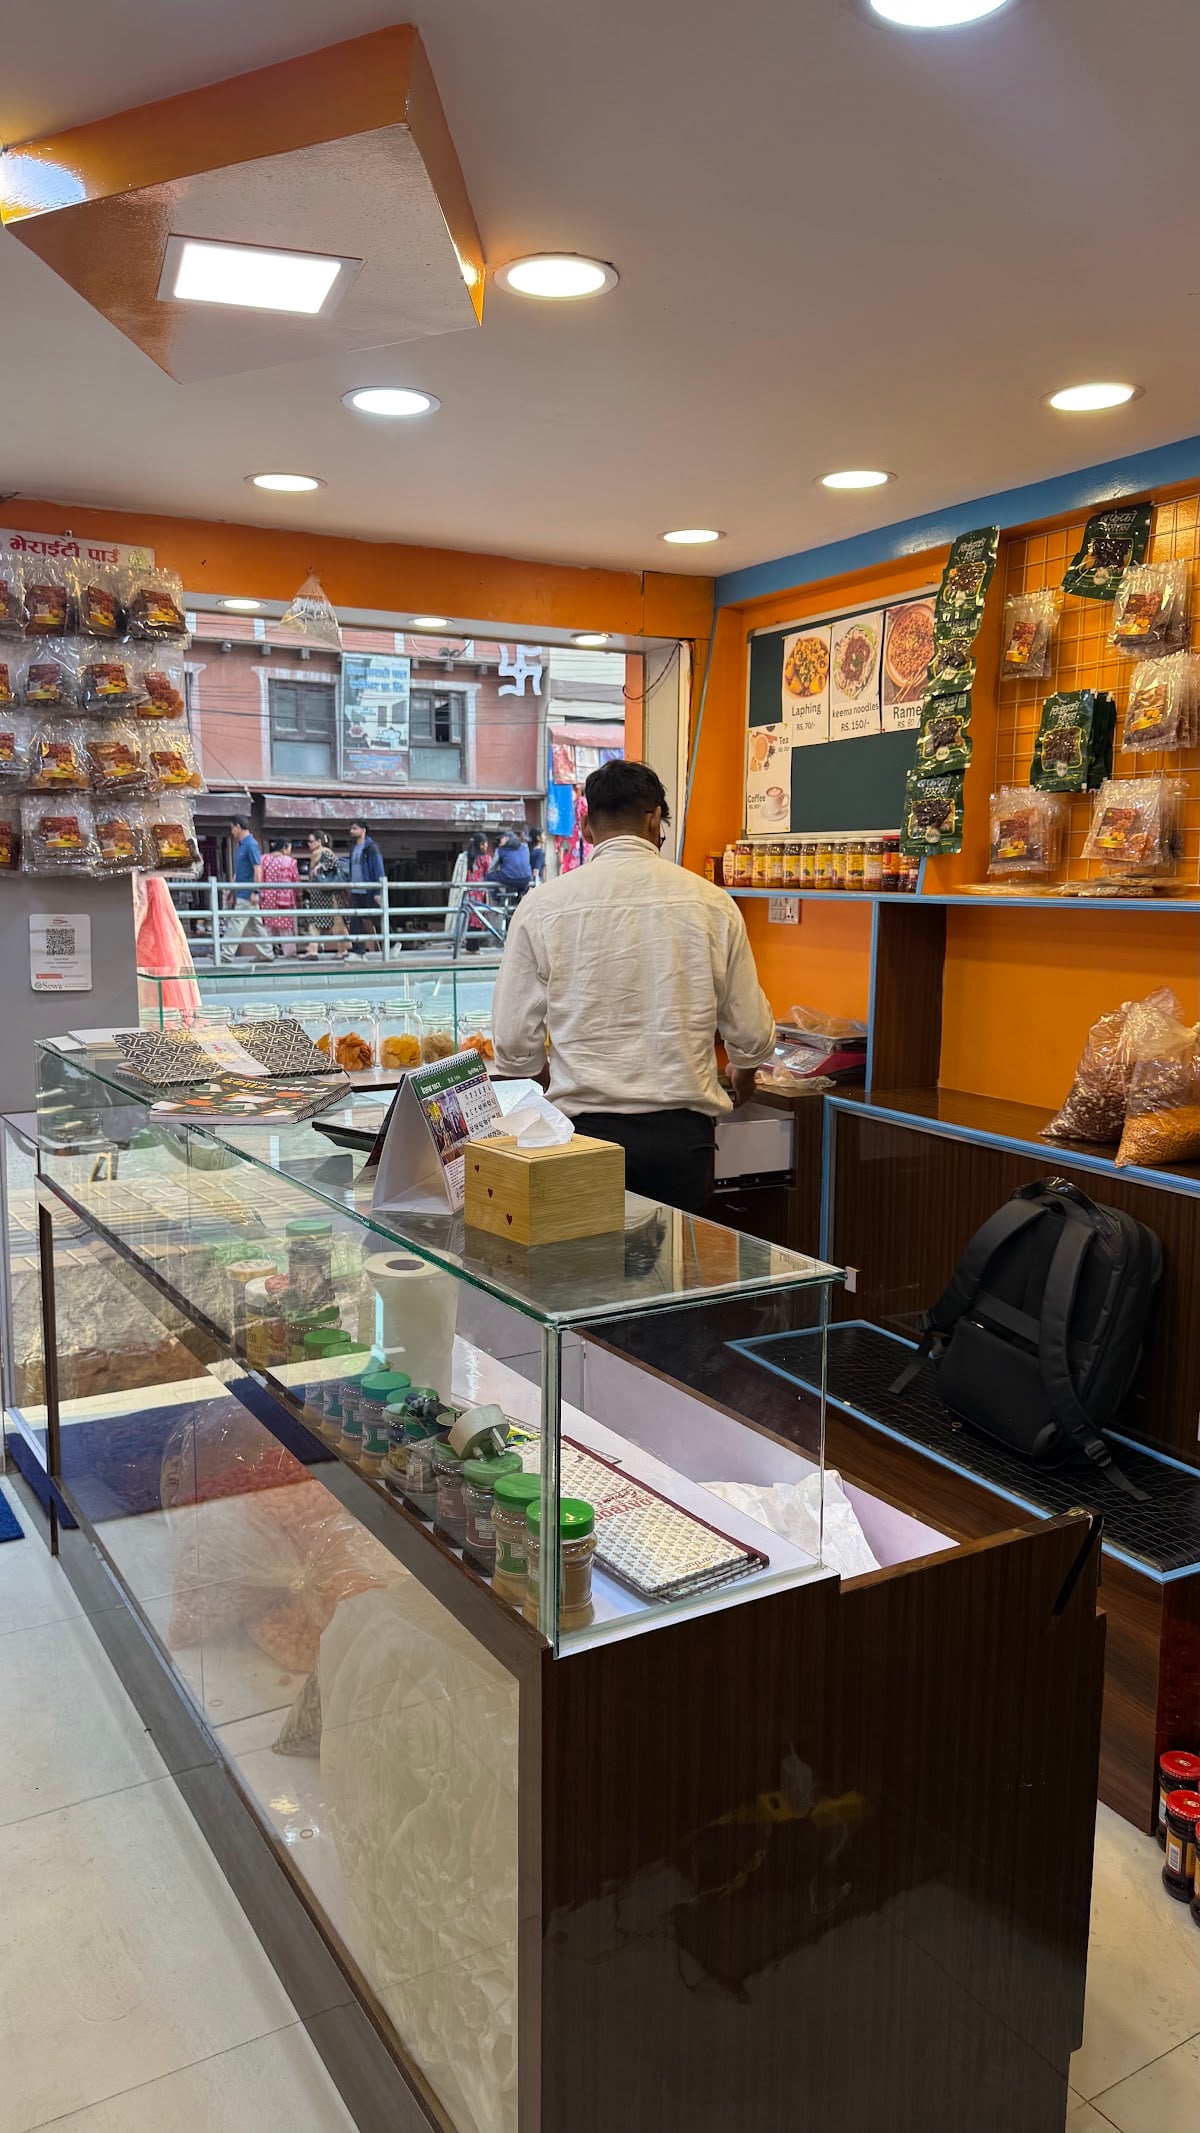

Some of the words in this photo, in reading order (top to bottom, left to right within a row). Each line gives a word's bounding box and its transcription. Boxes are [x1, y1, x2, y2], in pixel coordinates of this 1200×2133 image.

[791, 703, 822, 716] Laphing
[832, 708, 853, 718] keema
[853, 701, 879, 714] noodles
[893, 705, 922, 719] Rame
[851, 719, 870, 731] 150/-
[778, 736, 789, 744] Tea
[747, 793, 766, 803] Coffee
[594, 1496, 654, 1521] DAYBOO
